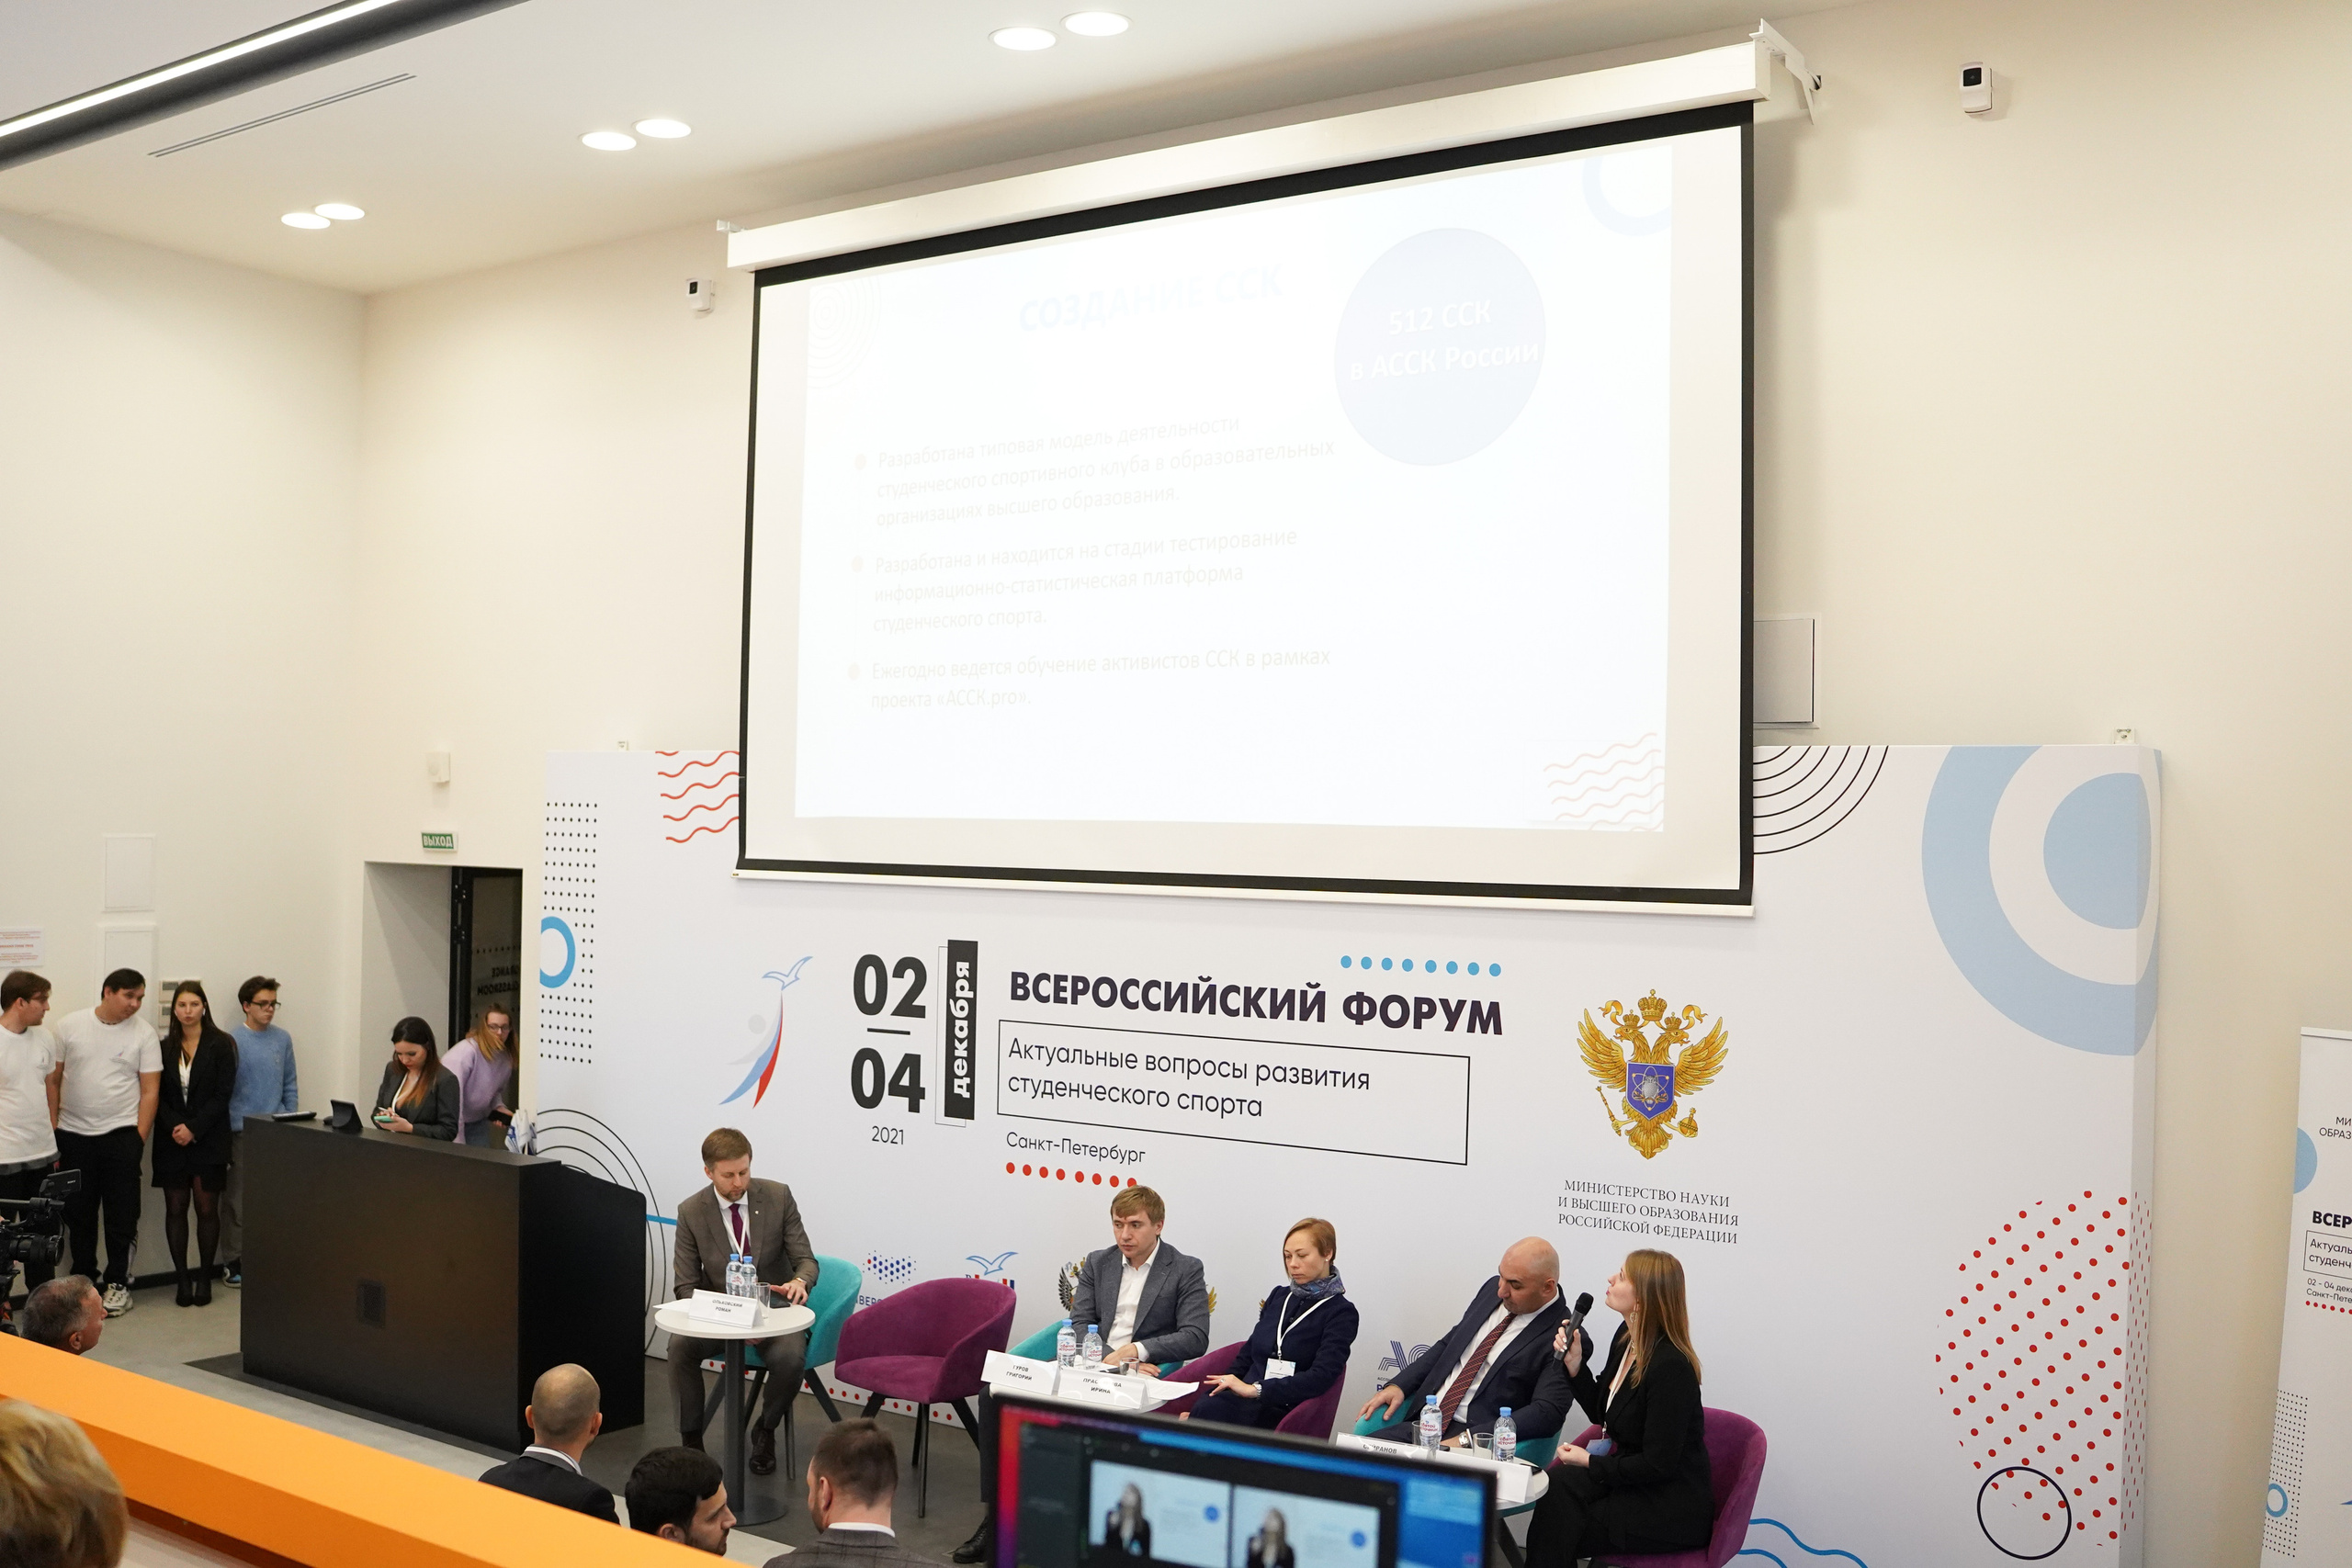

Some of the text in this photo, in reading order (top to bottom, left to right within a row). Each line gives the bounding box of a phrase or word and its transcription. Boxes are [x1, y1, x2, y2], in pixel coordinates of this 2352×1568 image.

[1020, 263, 1283, 332] СОЗДАНИЕ ССК
[1389, 299, 1492, 336] 512 ССК
[1351, 342, 1540, 381] в АССК России
[878, 415, 1239, 469] Разработана типовая модель деятельности
[876, 440, 1336, 501] студенческого спортивного клуба в образовательных
[876, 485, 1181, 528] организациях высшего образования.
[876, 529, 1297, 577] Разработана и находится на стадии тестирование
[874, 565, 1244, 605] информационно-статистическая платформа
[873, 608, 1047, 635] студенческого спорта.
[872, 649, 1330, 681] Ежегодно ведется обучение активистов ССК в рамках
[871, 691, 932, 713] проекта
[424, 835, 453, 847] ВЫХОД
[853, 953, 927, 1019] 02
[1011, 970, 1503, 1036] ВСЕРОССИЙСКИЙ ФОРУМ
[949, 960, 973, 1099] декабря
[851, 1046, 926, 1114] 04
[1008, 1037, 1370, 1092] Актуальные вопросы развития
[1008, 1074, 1263, 1120] студенческого спорта
[871, 1125, 905, 1146] 2021
[1006, 1131, 1146, 1164] Санкт-Петербург
[1558, 1197, 1739, 1226] И ВЫСШЕГО ОБРАЗОВАНИЯ
[1565, 1179, 1730, 1208] МИНИСТЕРСТВО НАУКИ
[1558, 1213, 1738, 1244] РОССИЙСКОЙ ФЕДЕРАЦИИ
[2307, 1278, 2316, 1286] 02
[2324, 1280, 2335, 1290] 04
[1012, 1364, 1030, 1372] ГУРОВ
